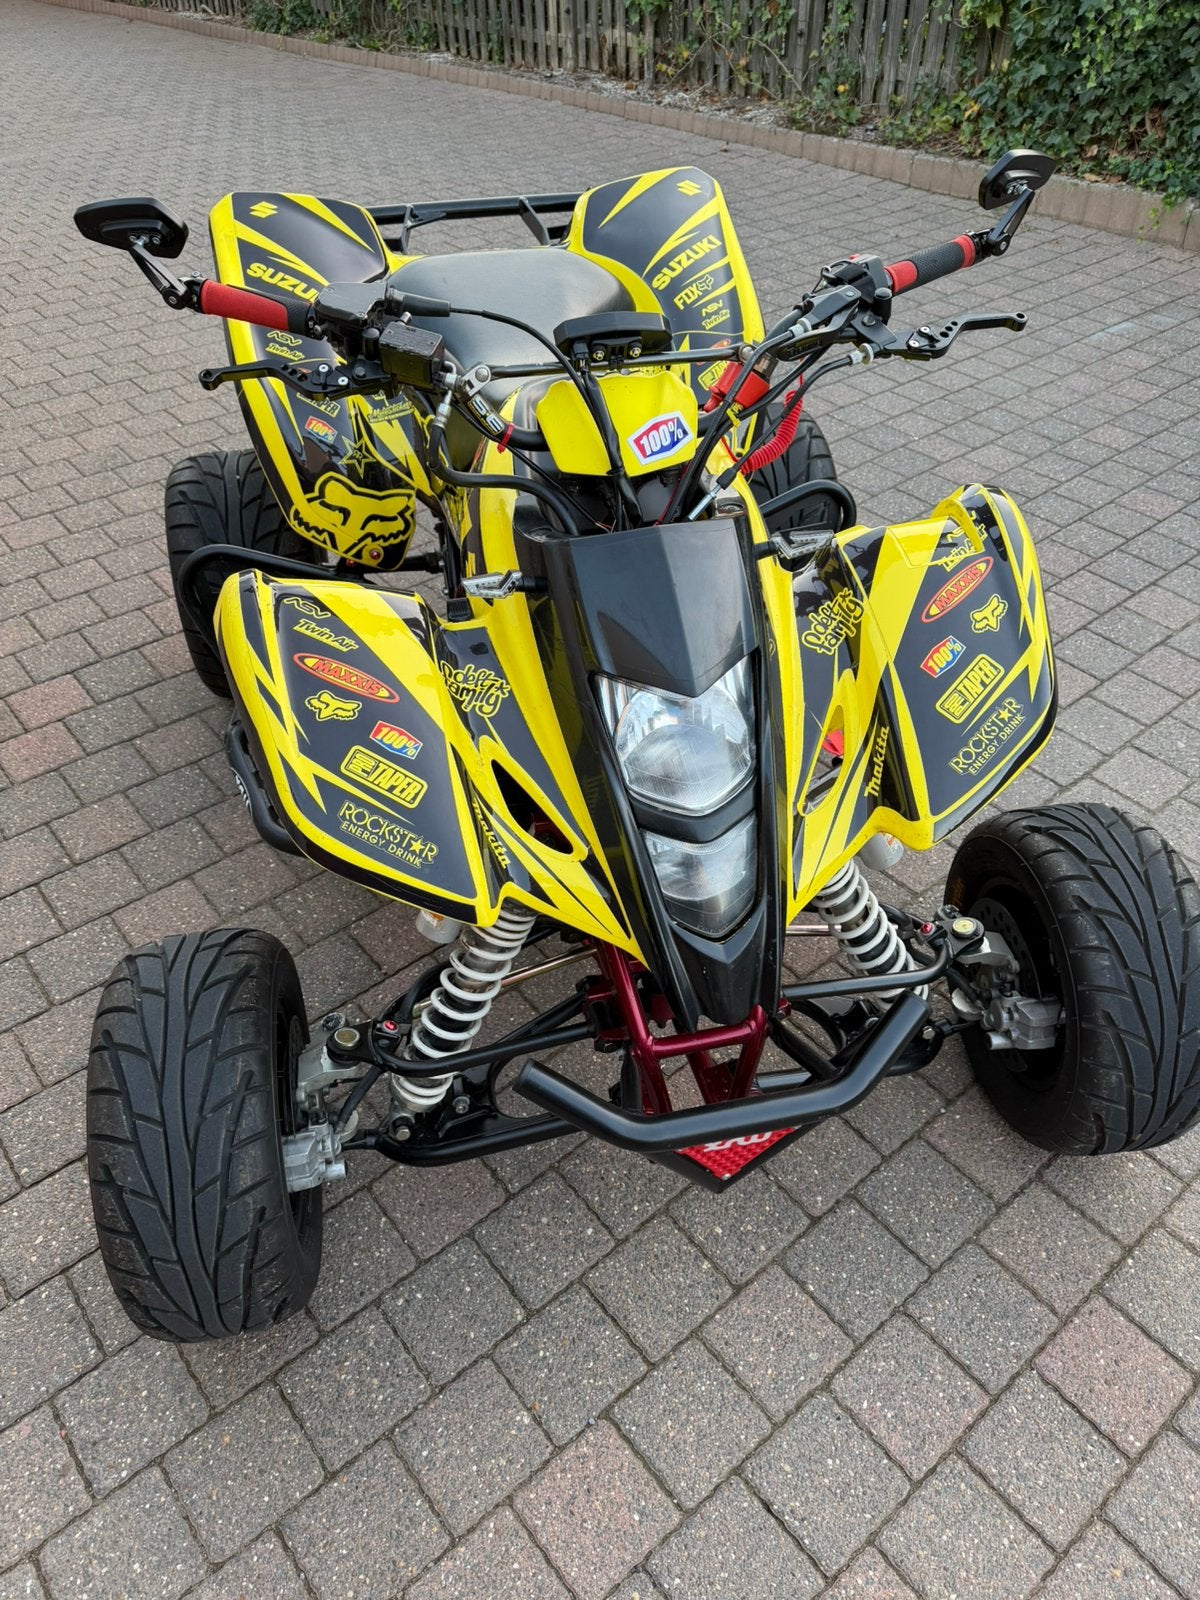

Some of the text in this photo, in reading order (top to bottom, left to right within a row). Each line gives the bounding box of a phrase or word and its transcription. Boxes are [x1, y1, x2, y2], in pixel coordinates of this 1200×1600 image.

[652, 234, 722, 290] SUZUKI
[246, 262, 319, 304] SUZU
[674, 283, 703, 310] FOX
[267, 330, 302, 346] ASV
[309, 419, 335, 441] 100%
[640, 416, 684, 457] 100%
[283, 596, 332, 619] ASV
[933, 566, 984, 612] MAXXIS
[927, 638, 963, 674] 100%
[310, 659, 383, 696] MAXXIS
[955, 658, 999, 703] TAPER
[375, 726, 421, 756] 100%
[863, 725, 890, 798] makita
[968, 712, 1025, 775] ENERGY DRINK
[367, 762, 422, 803] TAPER
[341, 820, 423, 867] ENERGY DRINK
